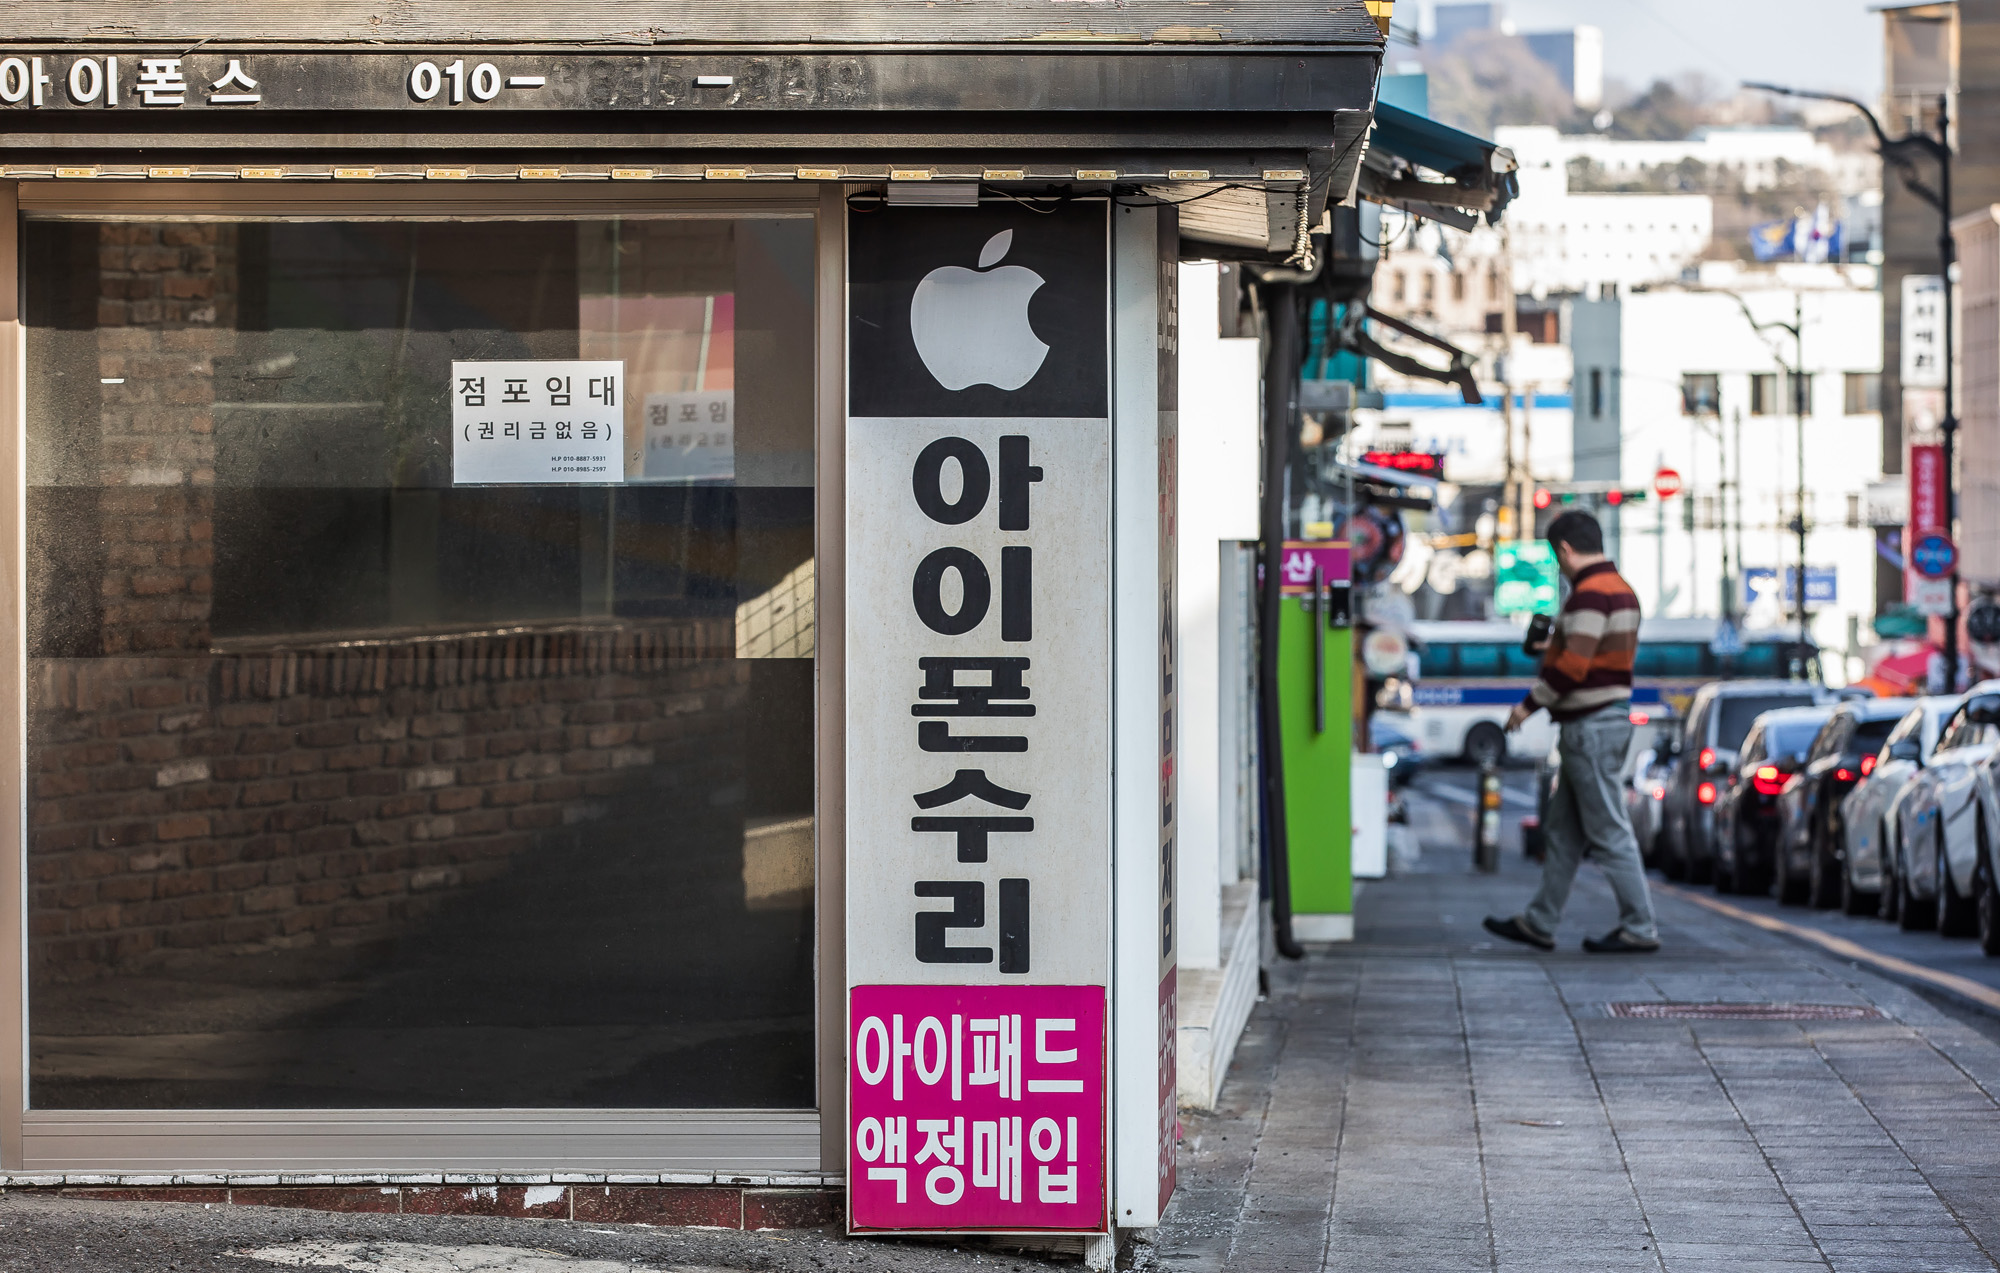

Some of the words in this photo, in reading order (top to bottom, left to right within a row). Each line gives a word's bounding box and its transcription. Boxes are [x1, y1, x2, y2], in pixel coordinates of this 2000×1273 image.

[459, 376, 615, 407] 점포임대
[911, 434, 1043, 973] 아이폰수리
[856, 1013, 1084, 1101] 아이패드
[856, 1116, 1078, 1206] 액정매입
